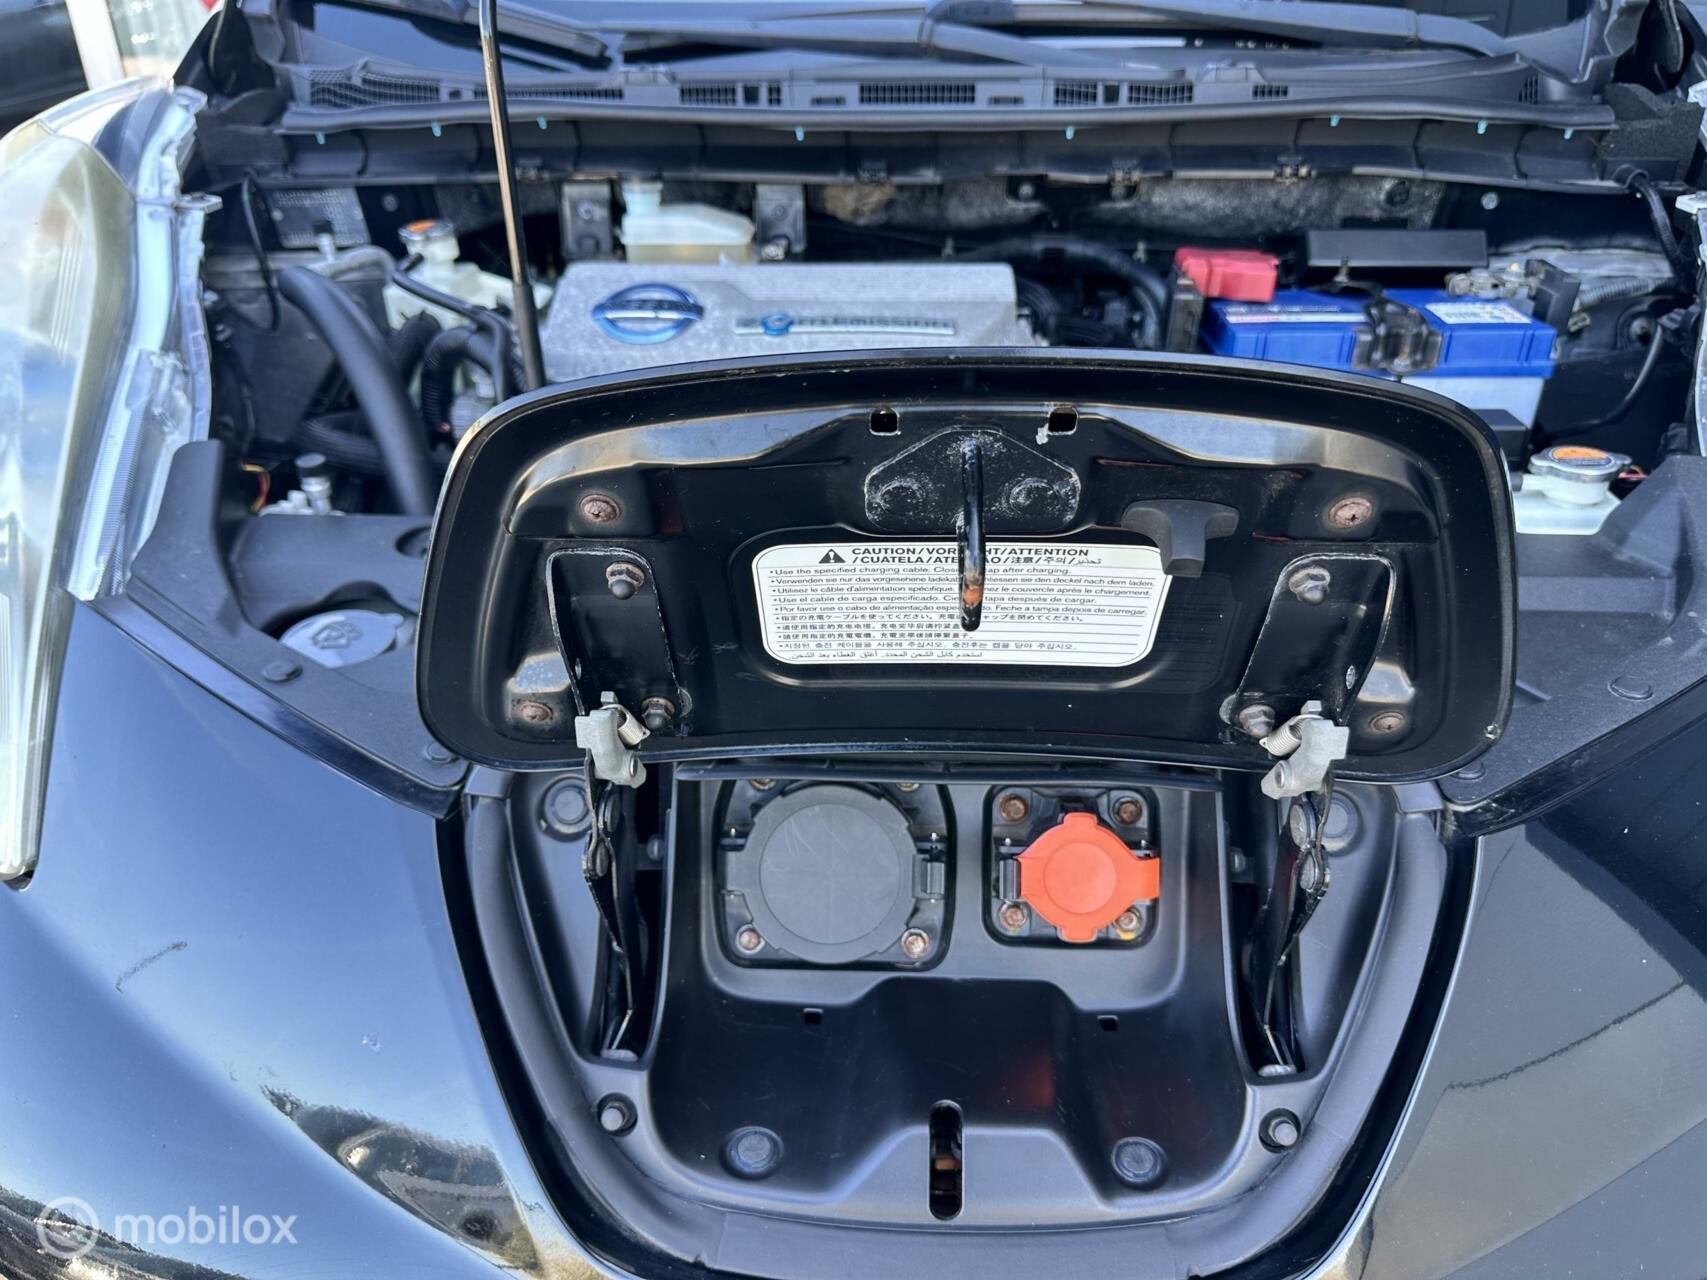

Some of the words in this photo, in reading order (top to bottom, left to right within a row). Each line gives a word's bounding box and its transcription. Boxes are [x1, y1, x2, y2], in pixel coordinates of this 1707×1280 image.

[814, 567, 856, 575] specified
[859, 567, 900, 575] charging
[1026, 567, 1071, 575] charging.
[1094, 588, 1151, 596] chargement.
[1107, 608, 1147, 616] carregar.
